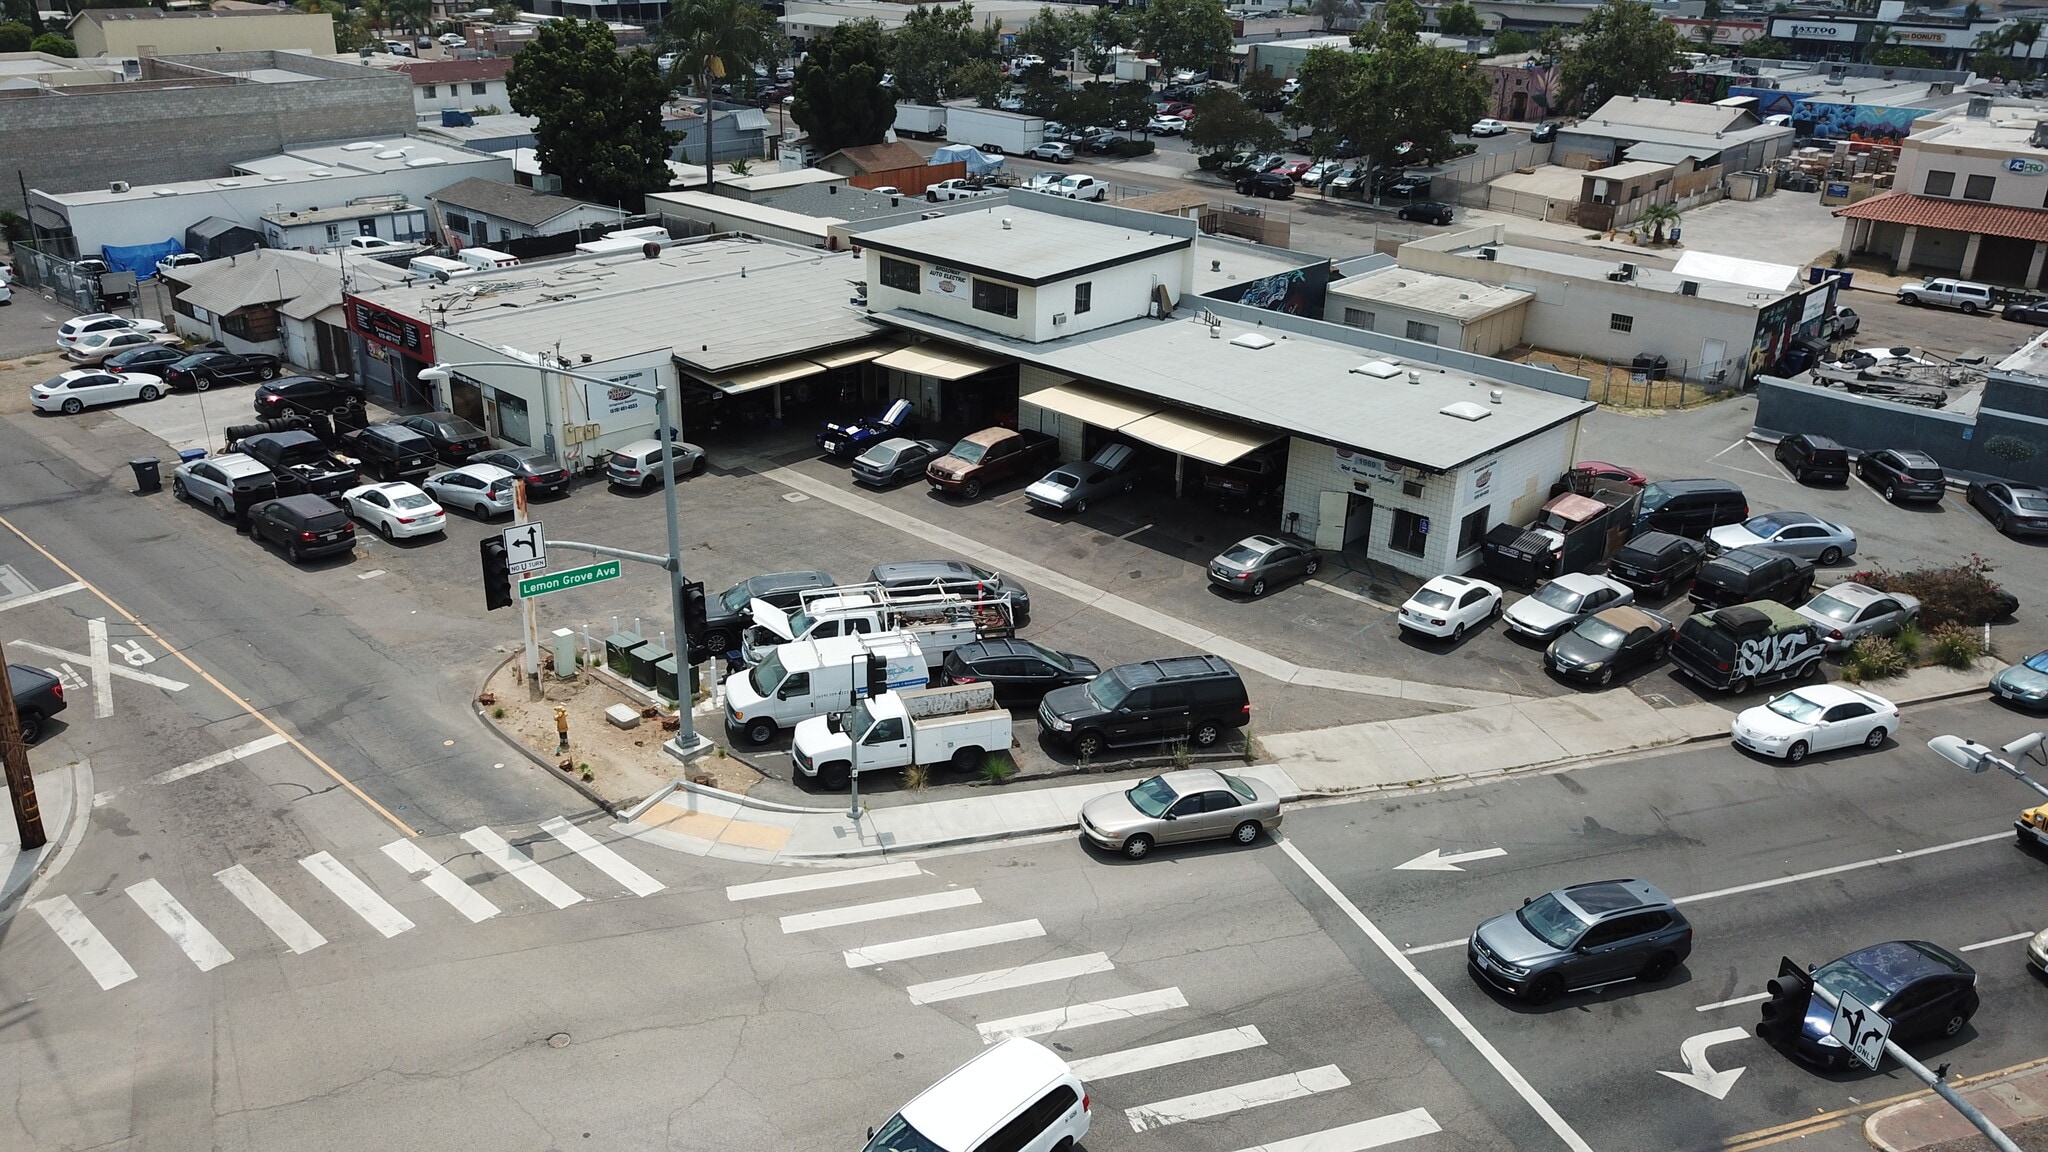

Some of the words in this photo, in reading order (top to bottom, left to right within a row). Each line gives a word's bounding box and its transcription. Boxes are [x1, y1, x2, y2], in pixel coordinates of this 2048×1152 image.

[1791, 25, 1837, 35] TATTOO
[2010, 161, 2024, 170] AC
[2025, 163, 2044, 172] PRO
[943, 273, 967, 283] ELECTRIC
[529, 560, 544, 568] TURN
[523, 579, 560, 594] Lemon
[562, 571, 593, 585] Grove
[596, 566, 616, 578] Ave
[1856, 1045, 1876, 1063] ONLY
